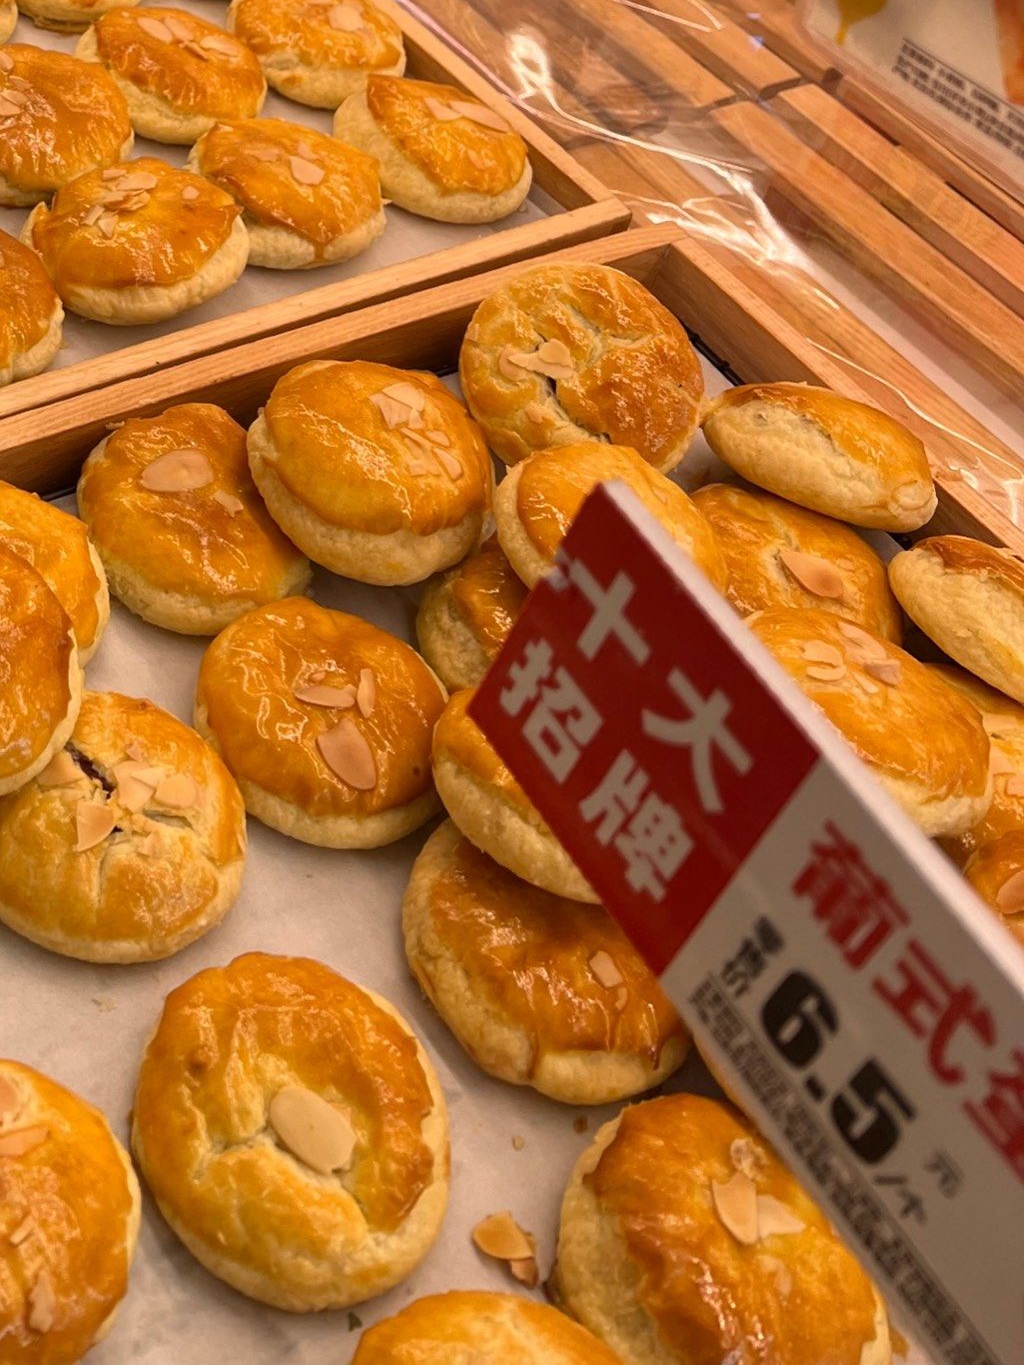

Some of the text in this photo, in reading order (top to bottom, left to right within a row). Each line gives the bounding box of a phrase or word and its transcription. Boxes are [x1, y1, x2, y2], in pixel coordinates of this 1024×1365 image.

[499, 638, 696, 903] 招牌
[570, 557, 754, 815] 十大
[761, 970, 917, 1166] 6.5
